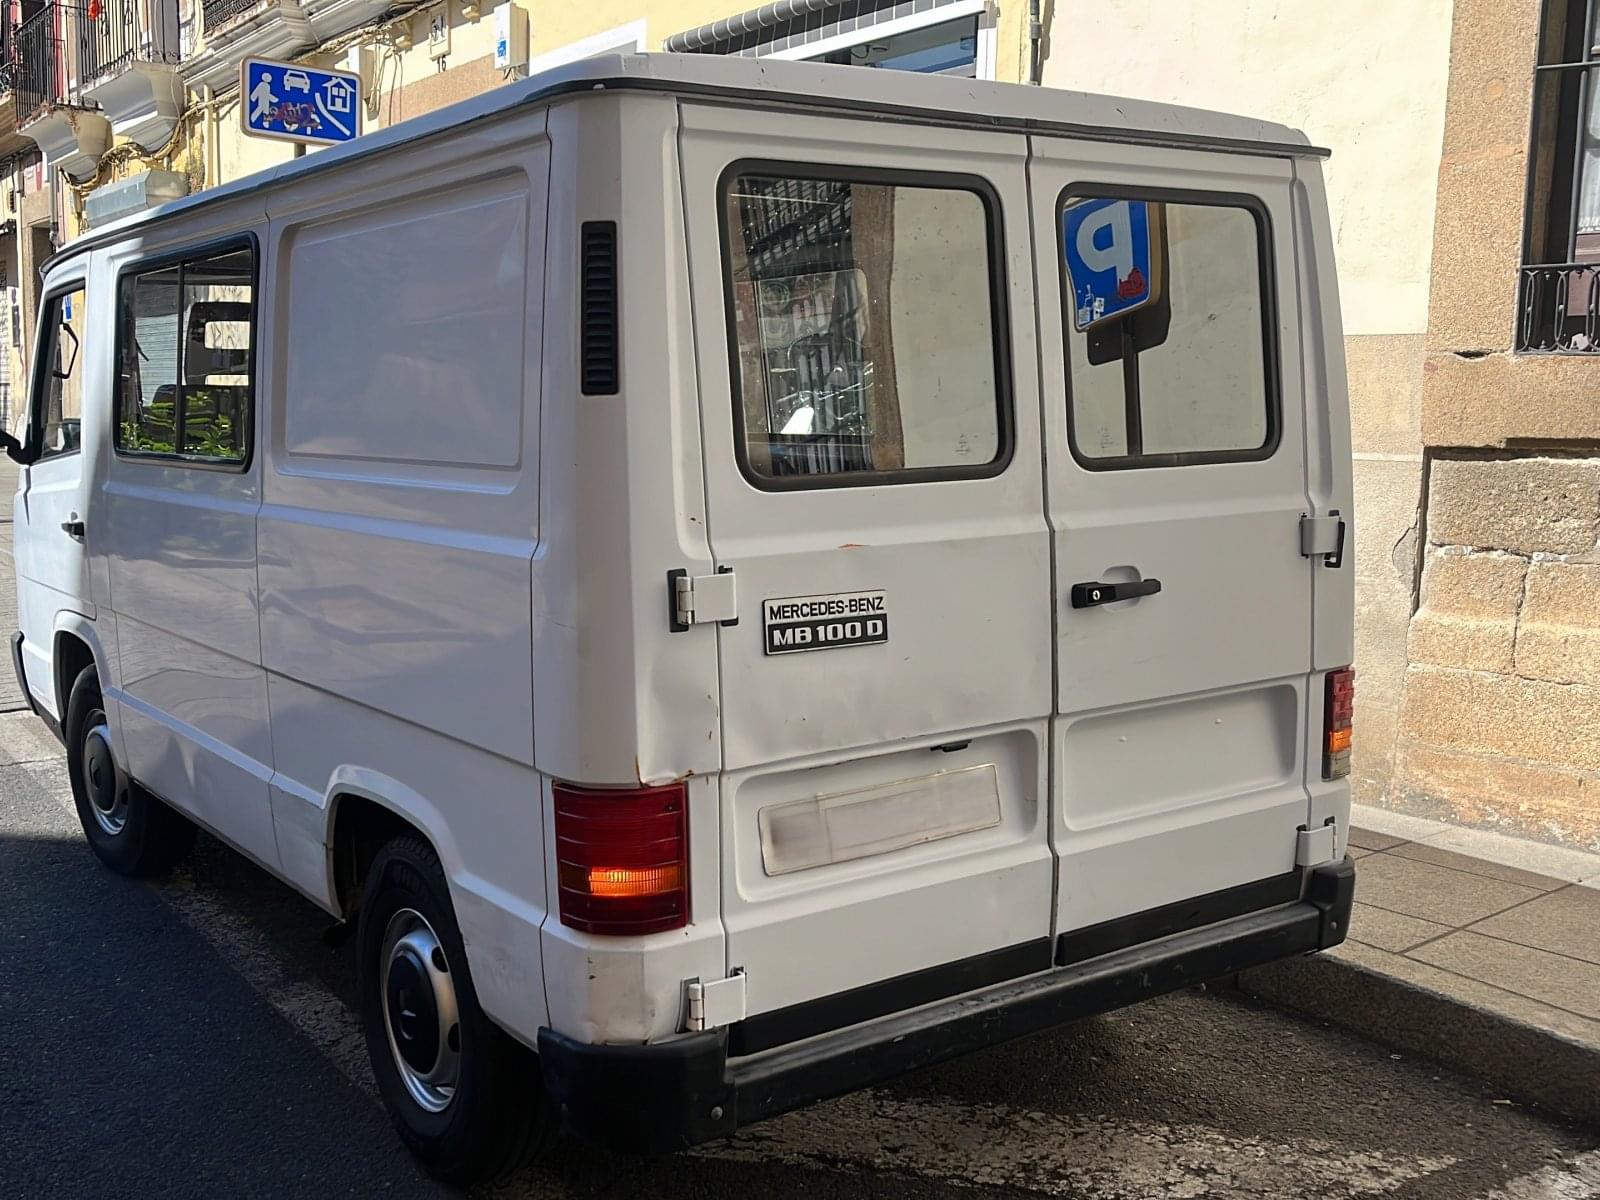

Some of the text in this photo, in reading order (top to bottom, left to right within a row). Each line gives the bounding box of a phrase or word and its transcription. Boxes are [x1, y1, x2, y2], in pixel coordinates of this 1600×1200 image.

[769, 597, 884, 620] MERCEDES-BENZ
[773, 620, 883, 646] MB 100 D
